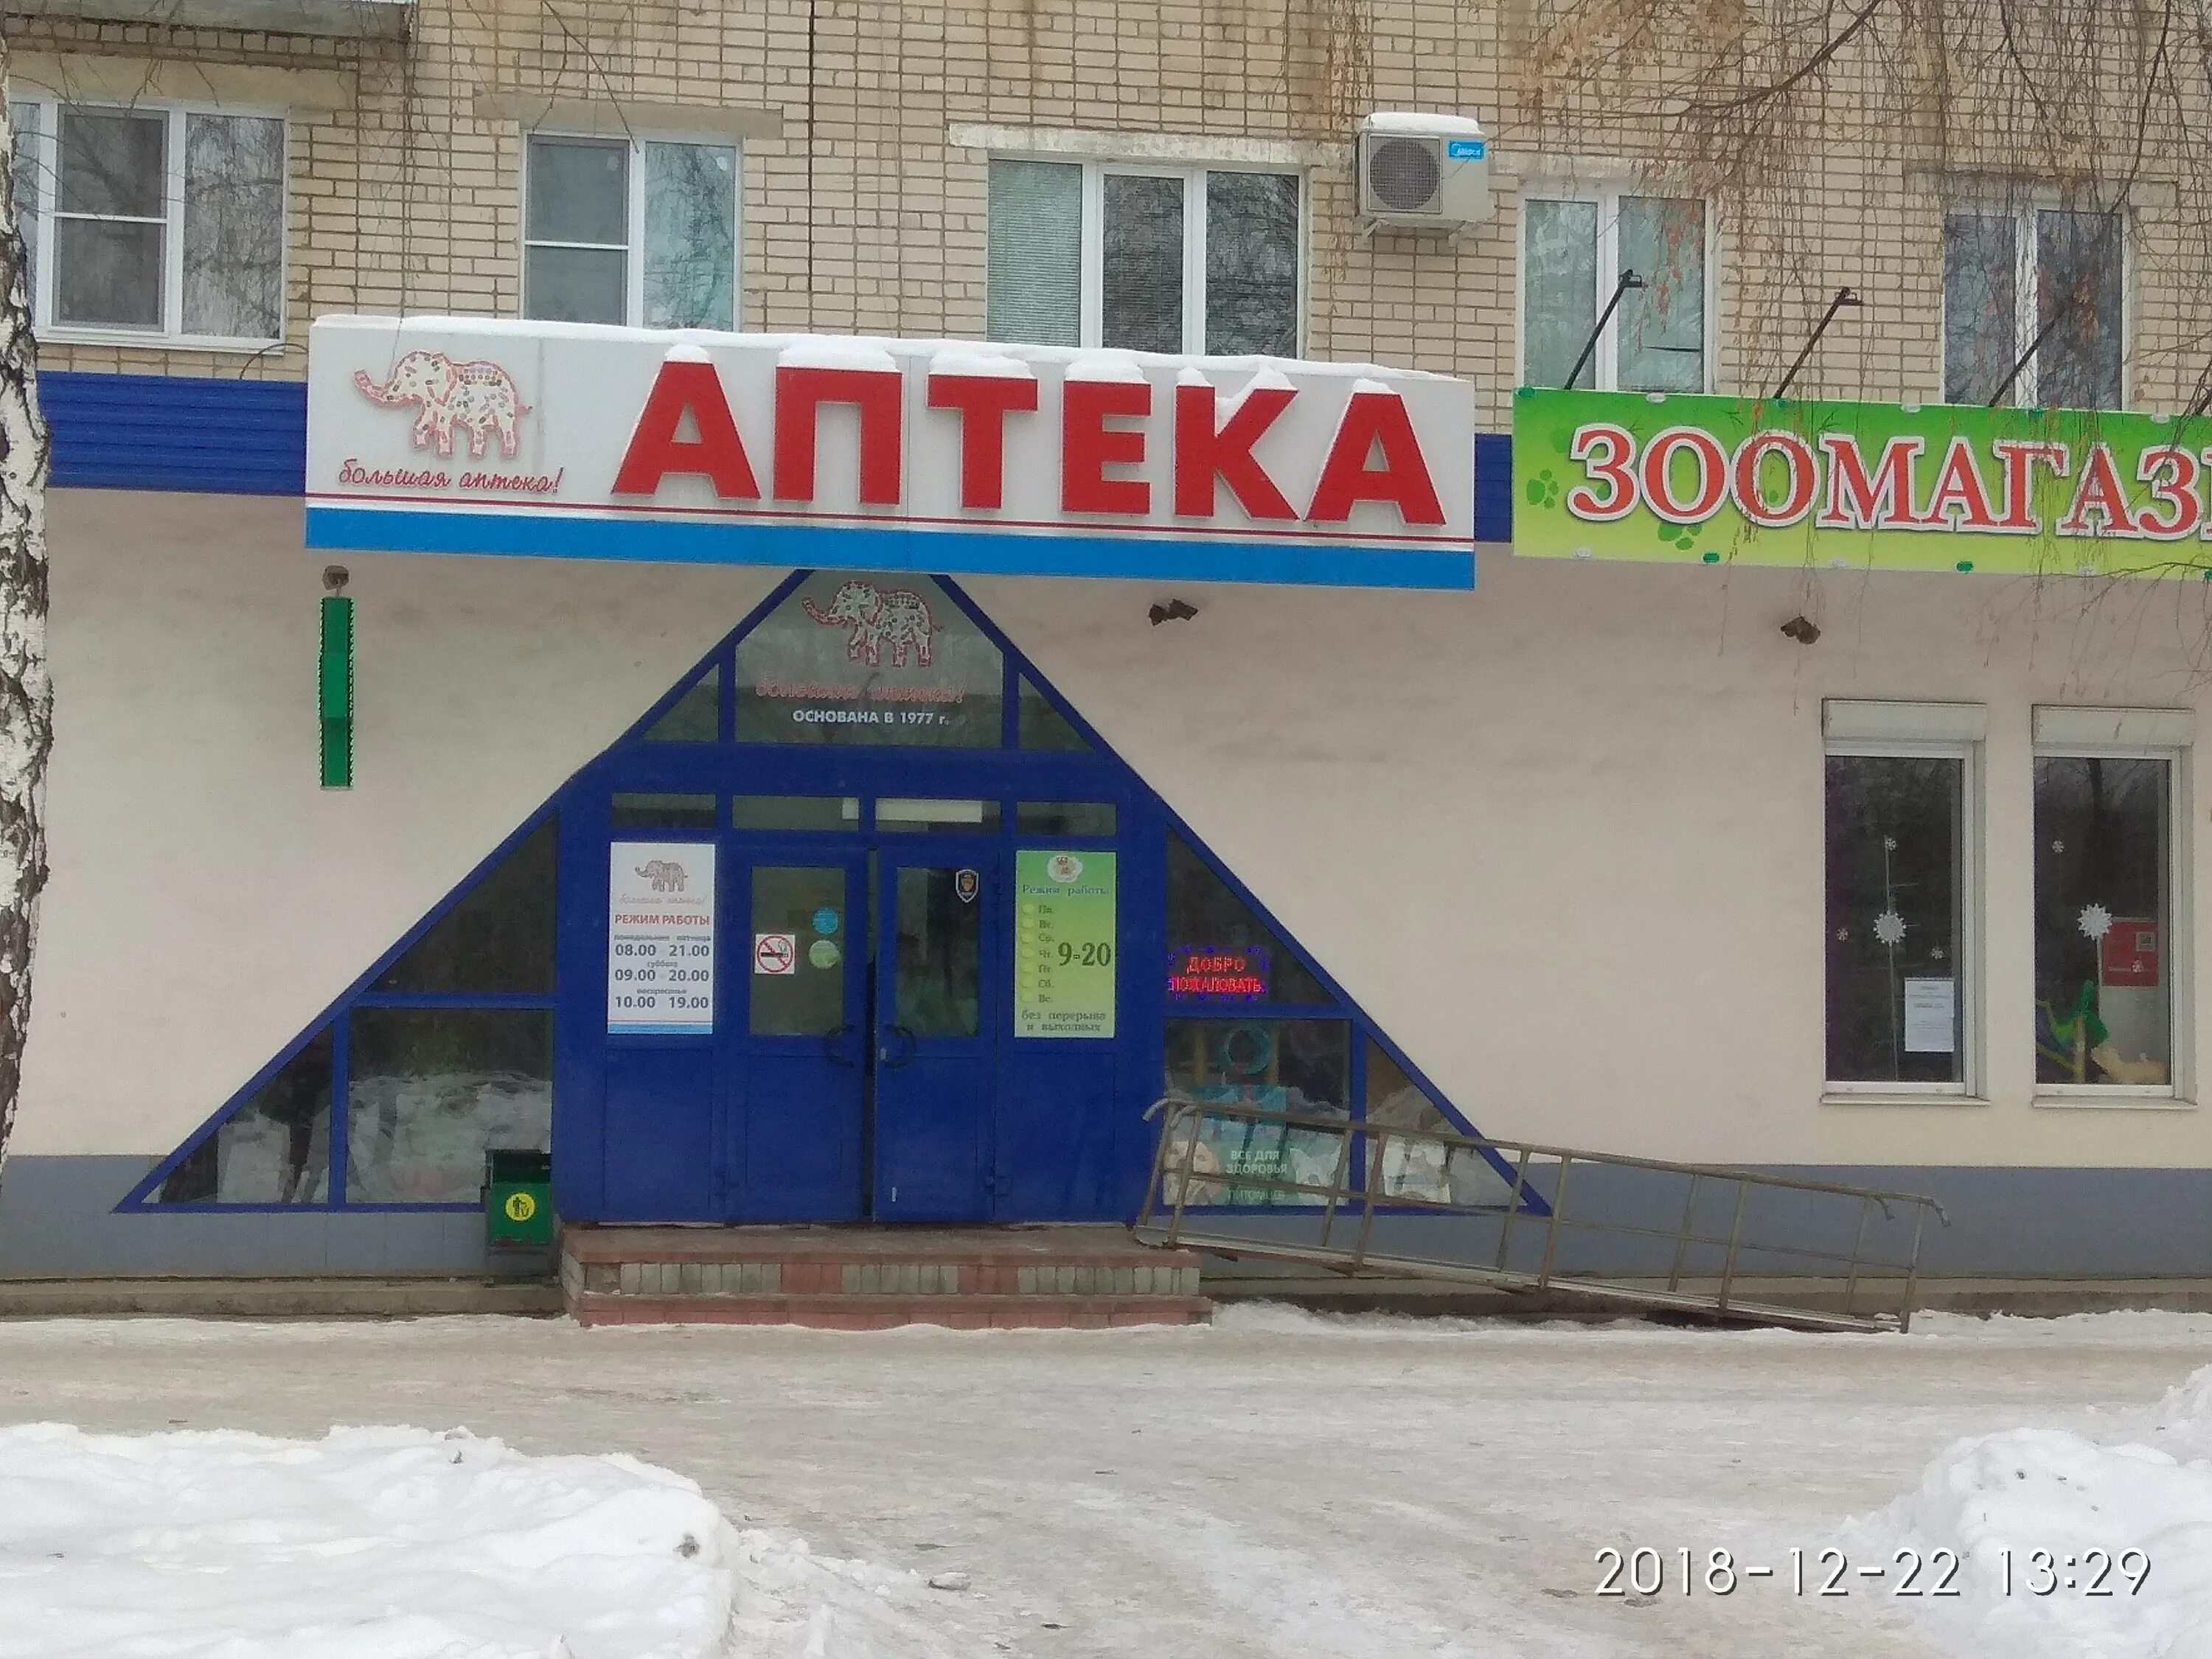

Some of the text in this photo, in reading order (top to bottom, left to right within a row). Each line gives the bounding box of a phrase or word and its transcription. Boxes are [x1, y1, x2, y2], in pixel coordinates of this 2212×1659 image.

[611, 361, 1447, 525] АПТЕКА
[338, 458, 564, 493] большая аптека!
[1567, 422, 2212, 541] ЗООМАГАЗ
[793, 709, 879, 724] ОСНОВАНА
[884, 712, 894, 724] В
[900, 712, 934, 725] 1977
[615, 914, 710, 925] РЕЖИМ РАБОТЫ
[615, 944, 709, 957] 08.00 21.00
[1058, 942, 1111, 967] 9-20
[1186, 956, 1246, 973] ДОБРО
[615, 969, 709, 982] 09.00 20.00
[1169, 977, 1262, 992] ПОЖАЛОВАТЬ
[615, 996, 709, 1009] 10.00 19.00
[1254, 1150, 1279, 1162] ДЛЯ
[1225, 1164, 1287, 1175] ЗДОРОВЬЯ
